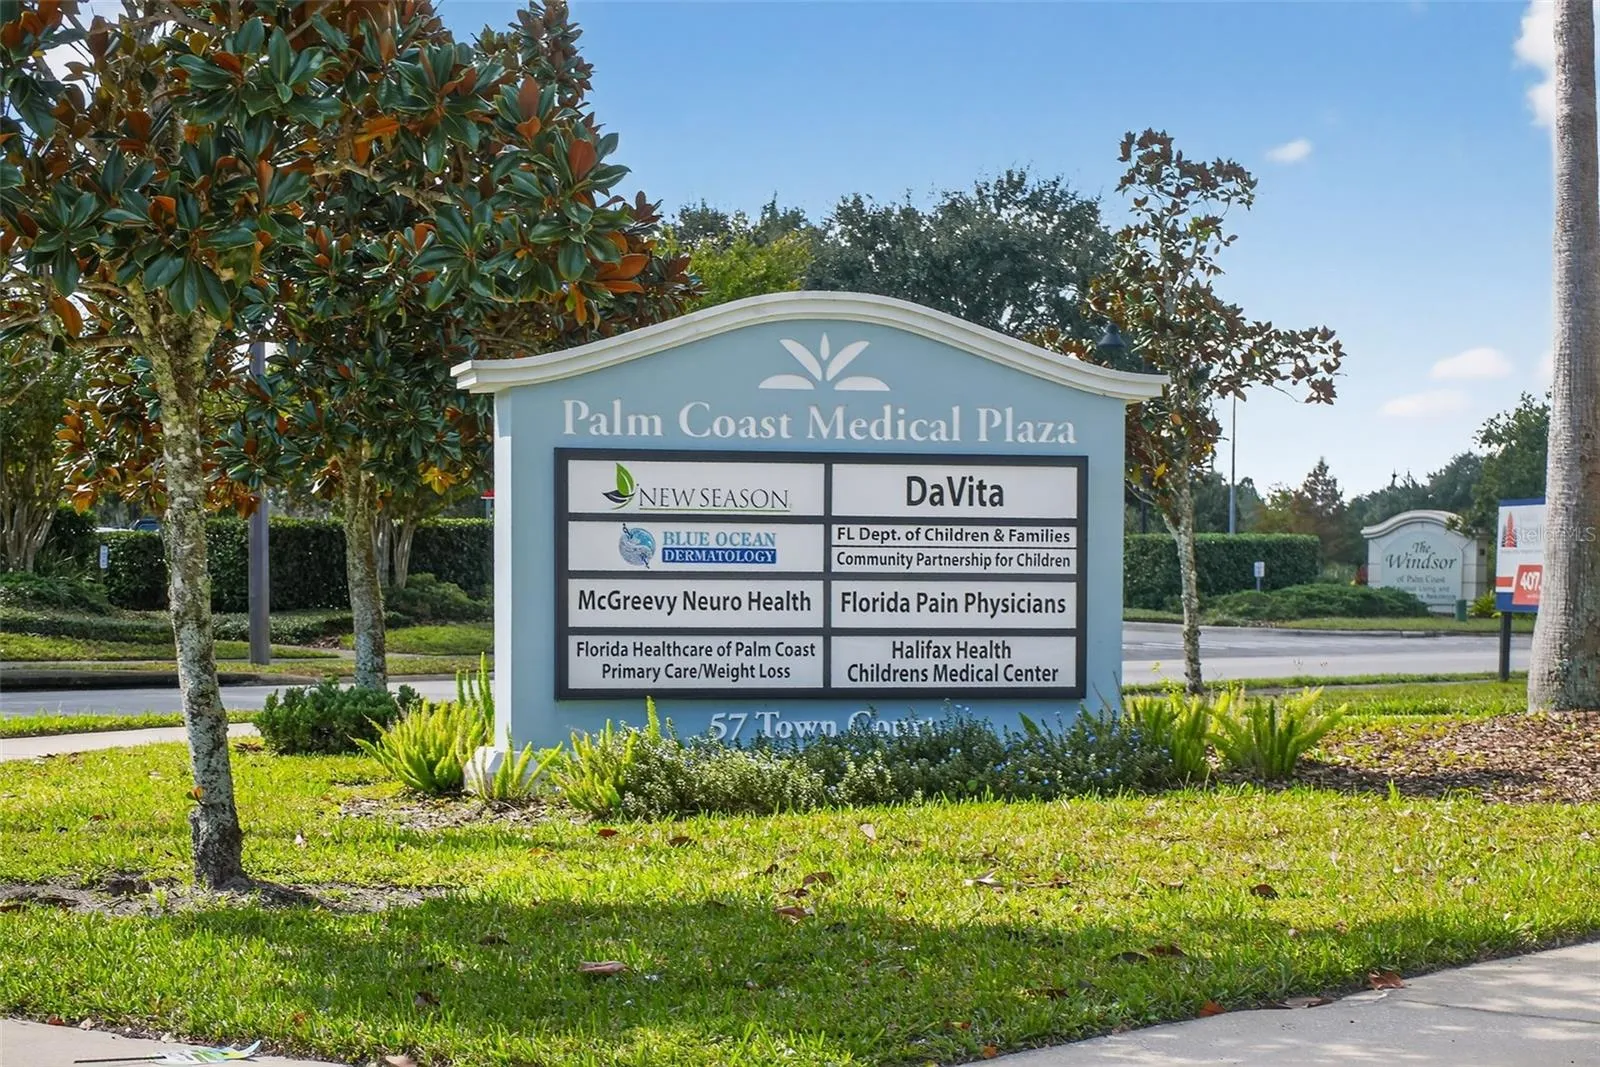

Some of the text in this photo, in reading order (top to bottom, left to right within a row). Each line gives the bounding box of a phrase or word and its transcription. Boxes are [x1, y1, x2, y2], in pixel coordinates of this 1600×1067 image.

[563, 398, 1077, 444] Palm Coast Medical Plaza
[639, 487, 788, 509] NEW SEASON
[906, 475, 1004, 507] DaVita
[662, 531, 776, 547] BLUE OCEAN
[837, 527, 1071, 545] FL Dept. of Children & Families
[664, 549, 775, 563] DERMATOLOGY
[1412, 541, 1431, 553] The
[837, 551, 1071, 570] Community Partnership for Children
[1385, 551, 1458, 570] Windsor
[578, 590, 811, 616] McGreevy Neuro Health
[841, 591, 1066, 618] Florida Pain Physicians
[577, 641, 816, 657] Florida Healthcare of Palm Coast
[892, 640, 1011, 659] Halifax Health
[602, 663, 791, 682] Primary Care/Weight Loss
[847, 664, 1059, 682] Childrens Medical Center
[710, 712, 748, 741] 57
[755, 711, 837, 739] Town
